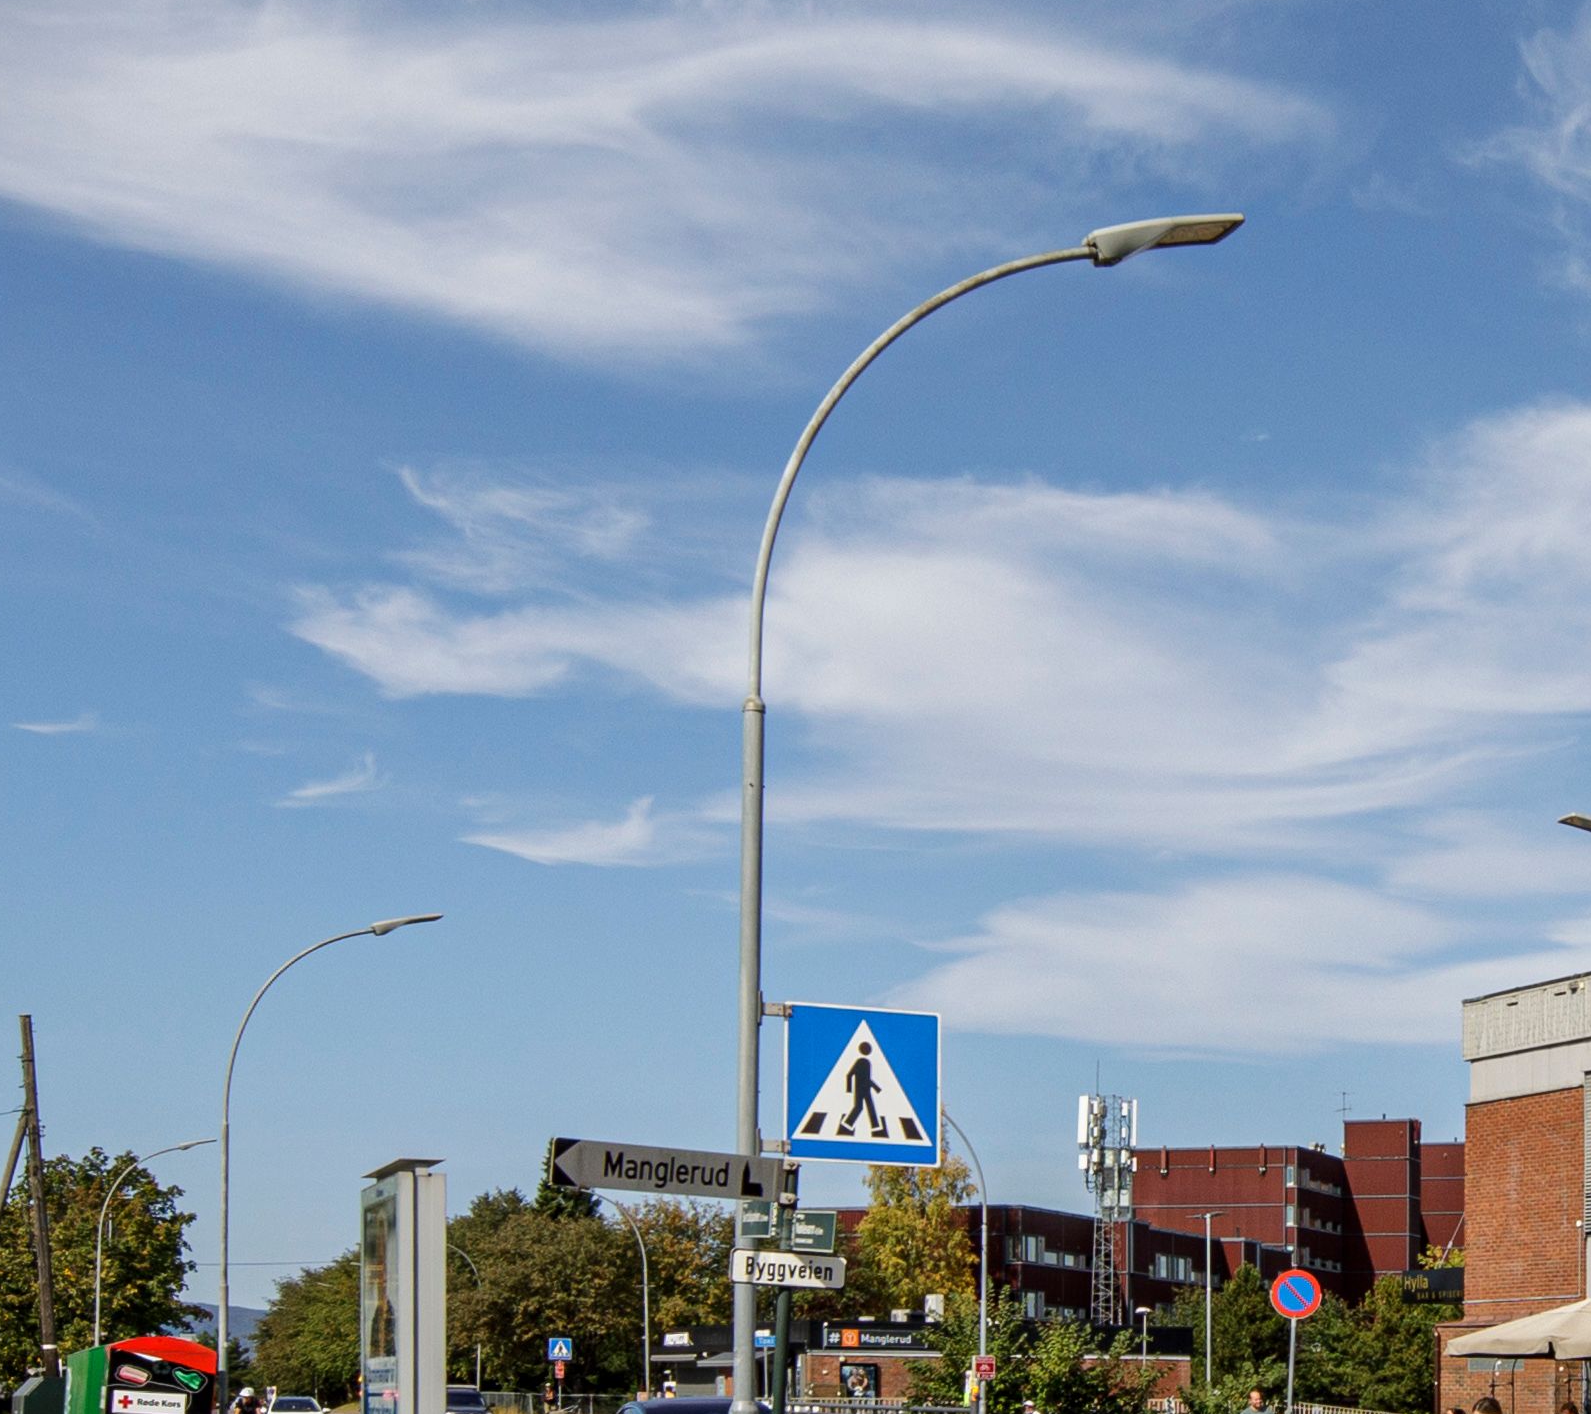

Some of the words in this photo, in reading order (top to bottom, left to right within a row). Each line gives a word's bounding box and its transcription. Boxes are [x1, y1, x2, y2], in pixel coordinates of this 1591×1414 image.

[604, 1151, 730, 1188] Manglerud
[746, 1256, 833, 1282] Byggveien
[861, 1334, 912, 1346] Manglerud
[161, 1400, 181, 1408] Kors
